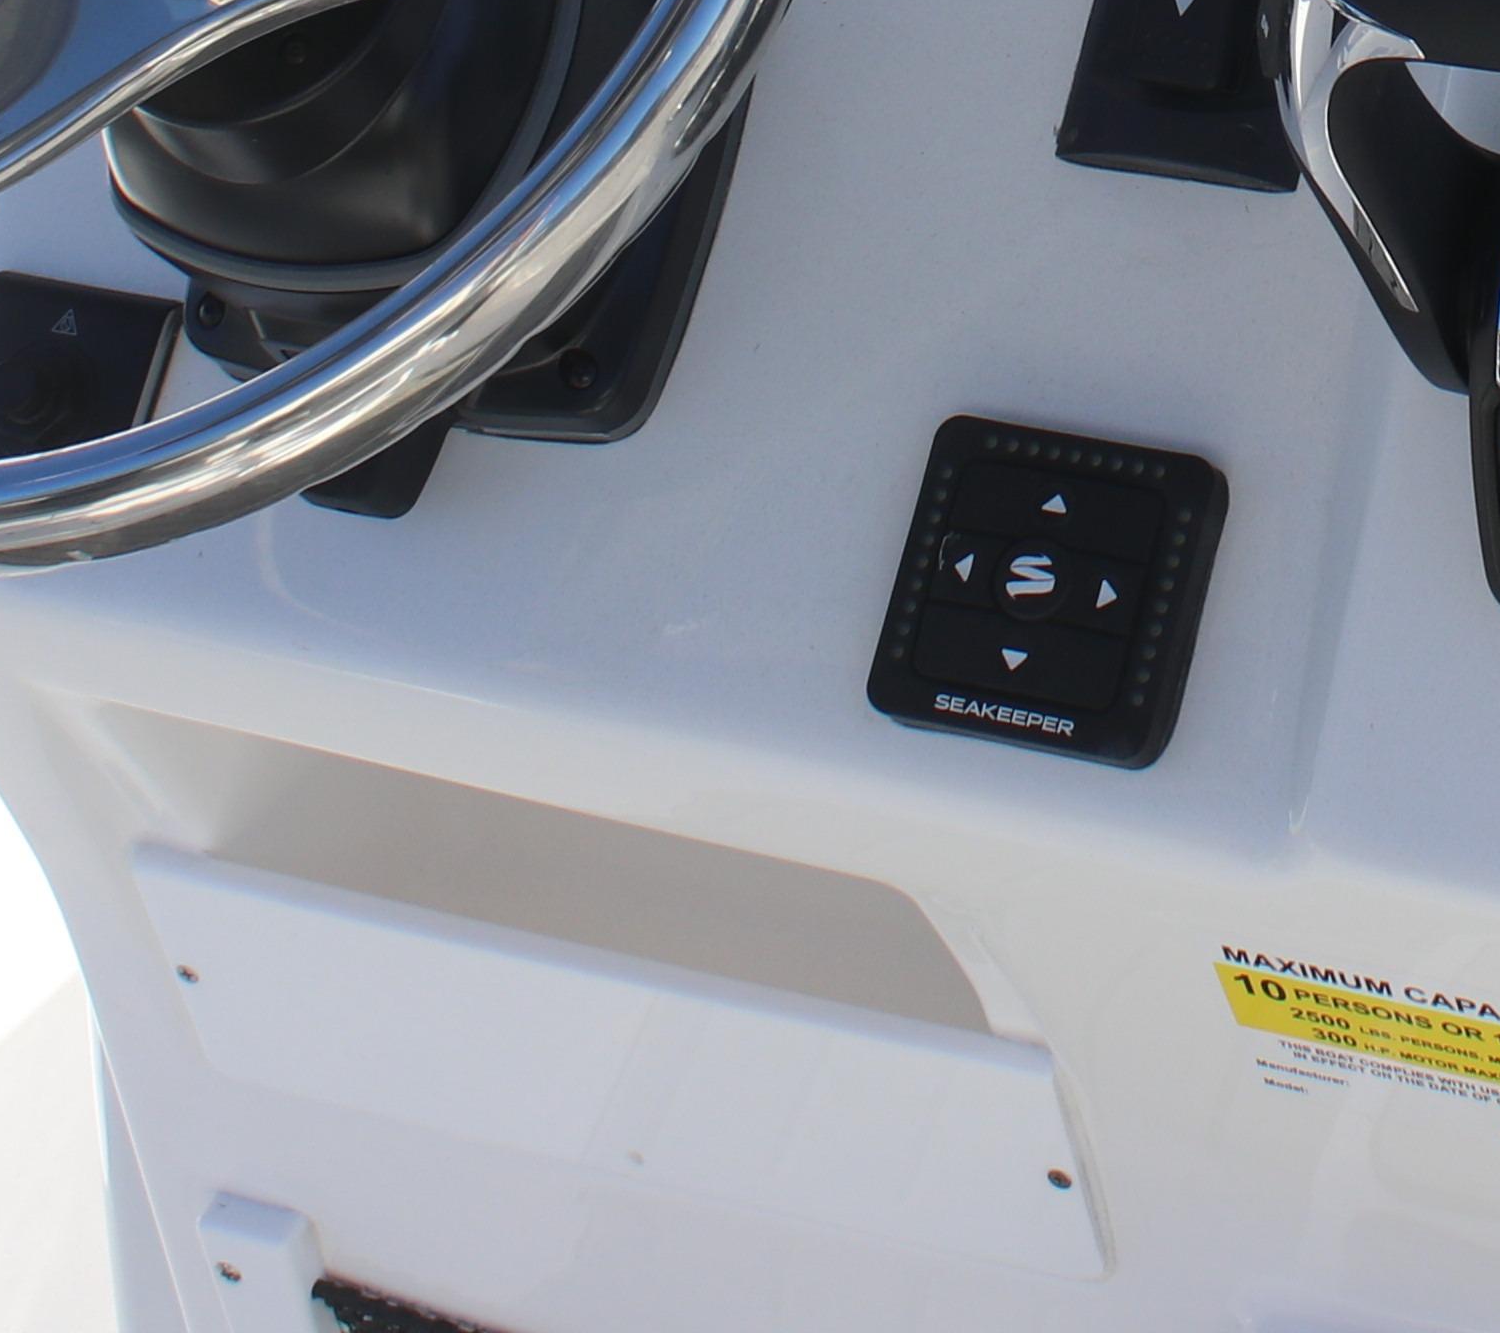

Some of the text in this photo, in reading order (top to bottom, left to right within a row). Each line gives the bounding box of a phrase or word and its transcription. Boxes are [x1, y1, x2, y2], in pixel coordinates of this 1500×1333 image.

[934, 693, 1075, 737] SEAKEEPER
[1222, 945, 1393, 997] MAXIMUM
[1233, 973, 1287, 1002] 10
[1293, 988, 1433, 1030] PERSONS
[1441, 1021, 1485, 1042] OR
[1290, 1007, 1351, 1031] 2500
[1256, 1057, 1350, 1087] Manufacturer:
[1278, 1039, 1312, 1054] THIS
[1315, 1047, 1355, 1063] BOAT
[1359, 1057, 1436, 1082] COMPLIES
[1438, 1075, 1477, 1092] WITH
[1312, 1027, 1358, 1048] 300
[1400, 1051, 1459, 1072] MOTOR
[1263, 1076, 1309, 1095] Model:
[1310, 1055, 1366, 1075] EFFECT
[1370, 1068, 1393, 1081] ON
[1397, 1074, 1426, 1088] THE
[1429, 1082, 1469, 1098] DATE
[1472, 1091, 1492, 1102] OF
